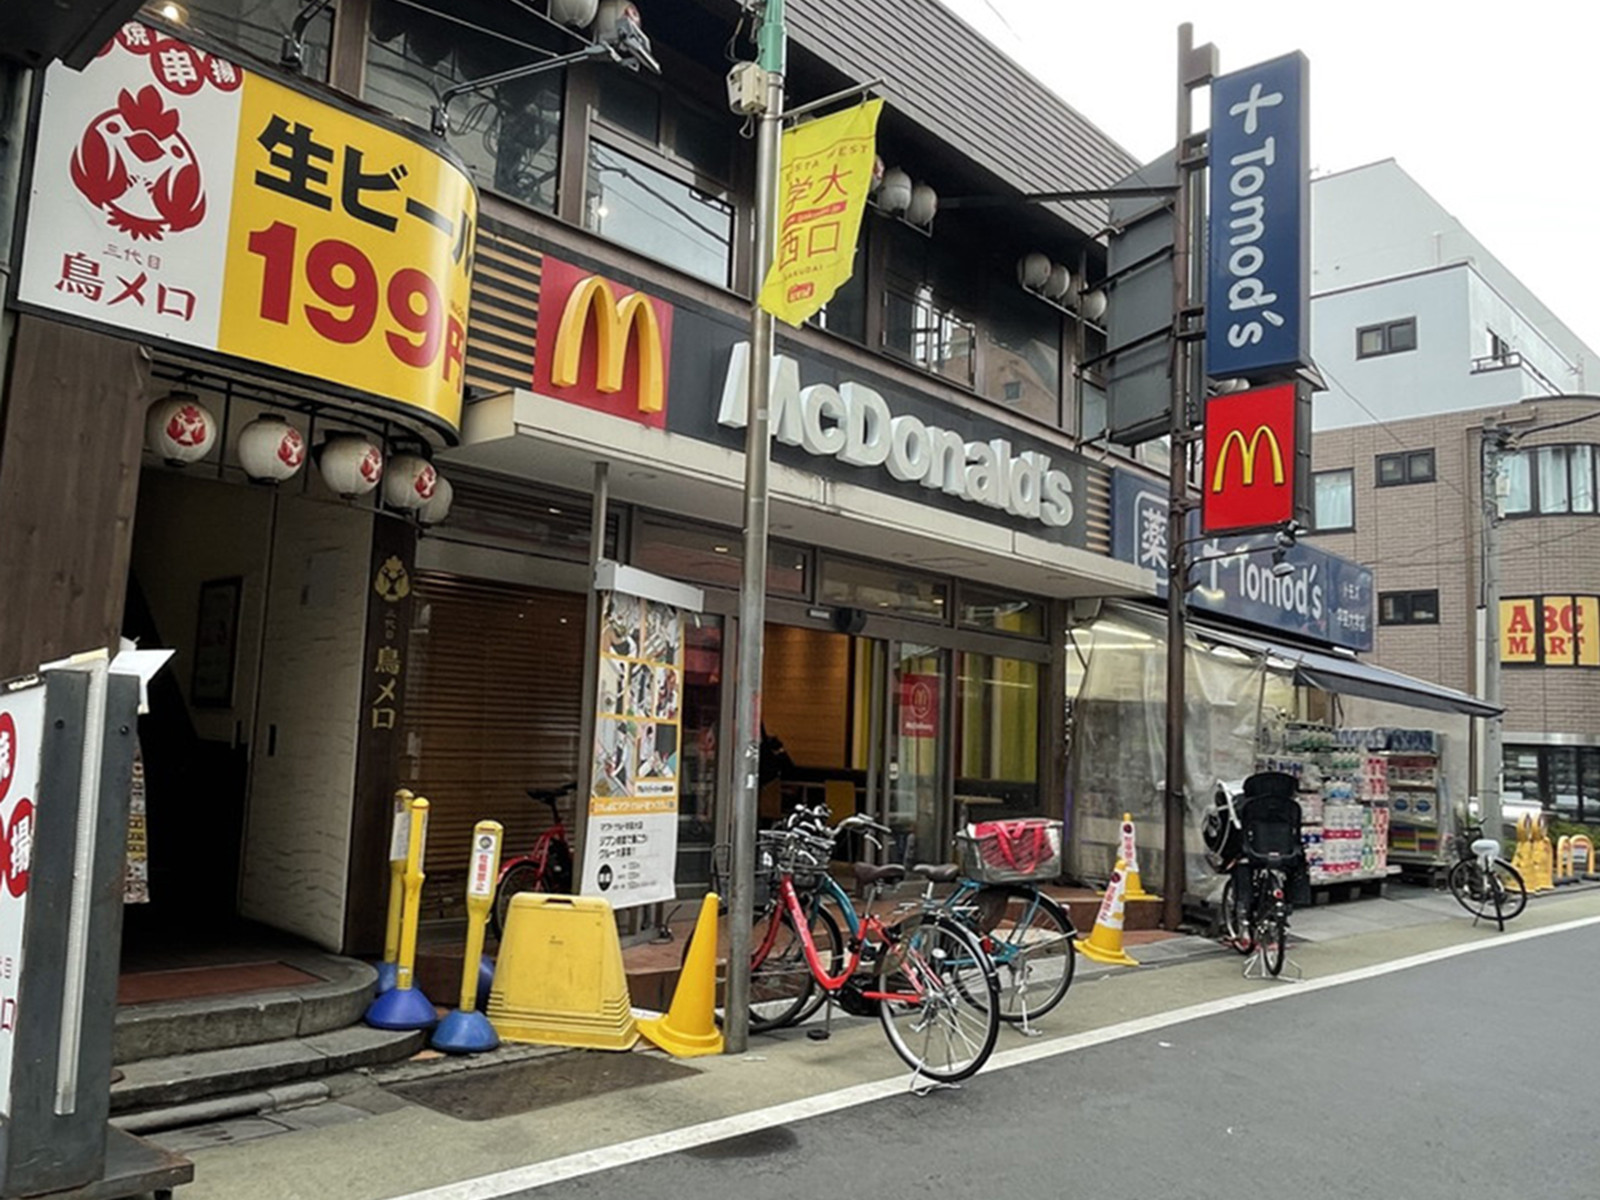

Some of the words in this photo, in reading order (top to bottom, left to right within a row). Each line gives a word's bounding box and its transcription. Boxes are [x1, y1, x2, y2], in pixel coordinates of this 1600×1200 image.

[159, 48, 198, 87] 串
[253, 113, 475, 278] 生ビール
[102, 243, 161, 270] 三代目
[1227, 136, 1285, 348] Tomod's
[54, 252, 197, 322] 鳥メロ
[717, 341, 1074, 528] McDonald's
[1141, 507, 1168, 569] 薬
[1235, 545, 1322, 620] Tomod's
[1507, 605, 1584, 634] ABC
[1507, 636, 1585, 656] MRT
[371, 645, 401, 729] 鳥メロ
